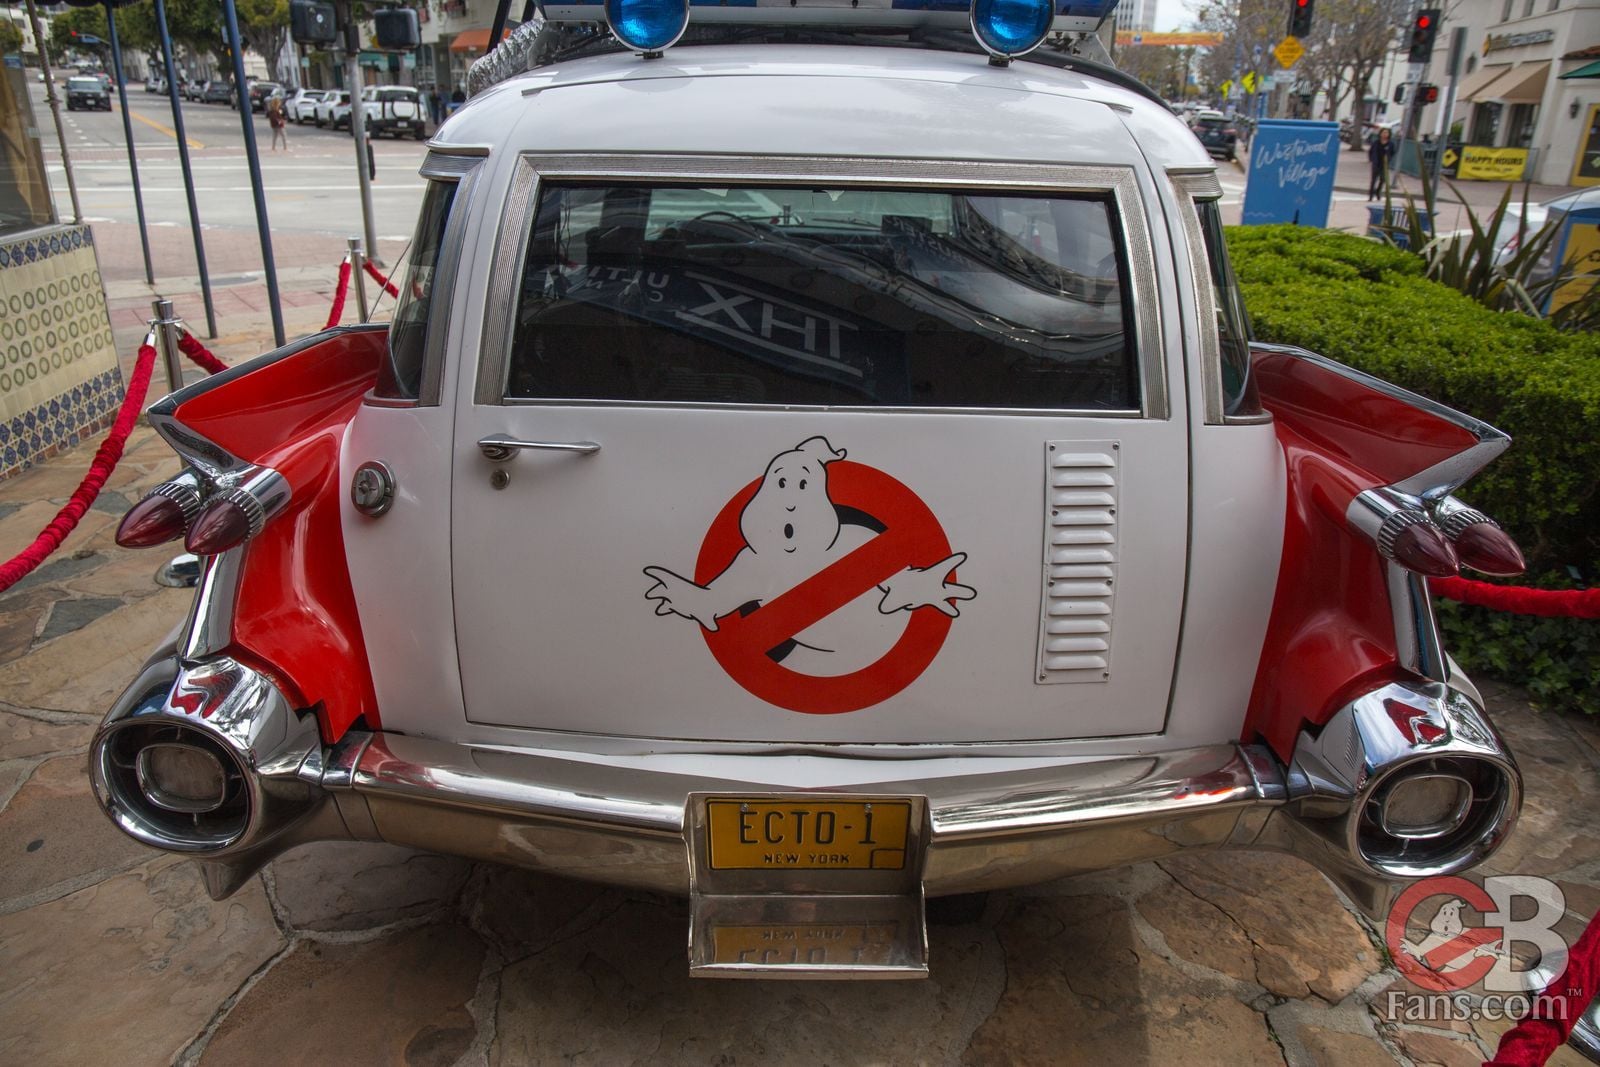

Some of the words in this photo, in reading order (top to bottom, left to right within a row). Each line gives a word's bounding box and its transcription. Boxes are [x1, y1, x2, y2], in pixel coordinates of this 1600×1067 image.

[1256, 133, 1332, 169] Westwood
[1279, 162, 1330, 190] Village
[739, 811, 876, 845] ECTO-1
[764, 853, 800, 864] NEW
[809, 853, 850, 864] YORK
